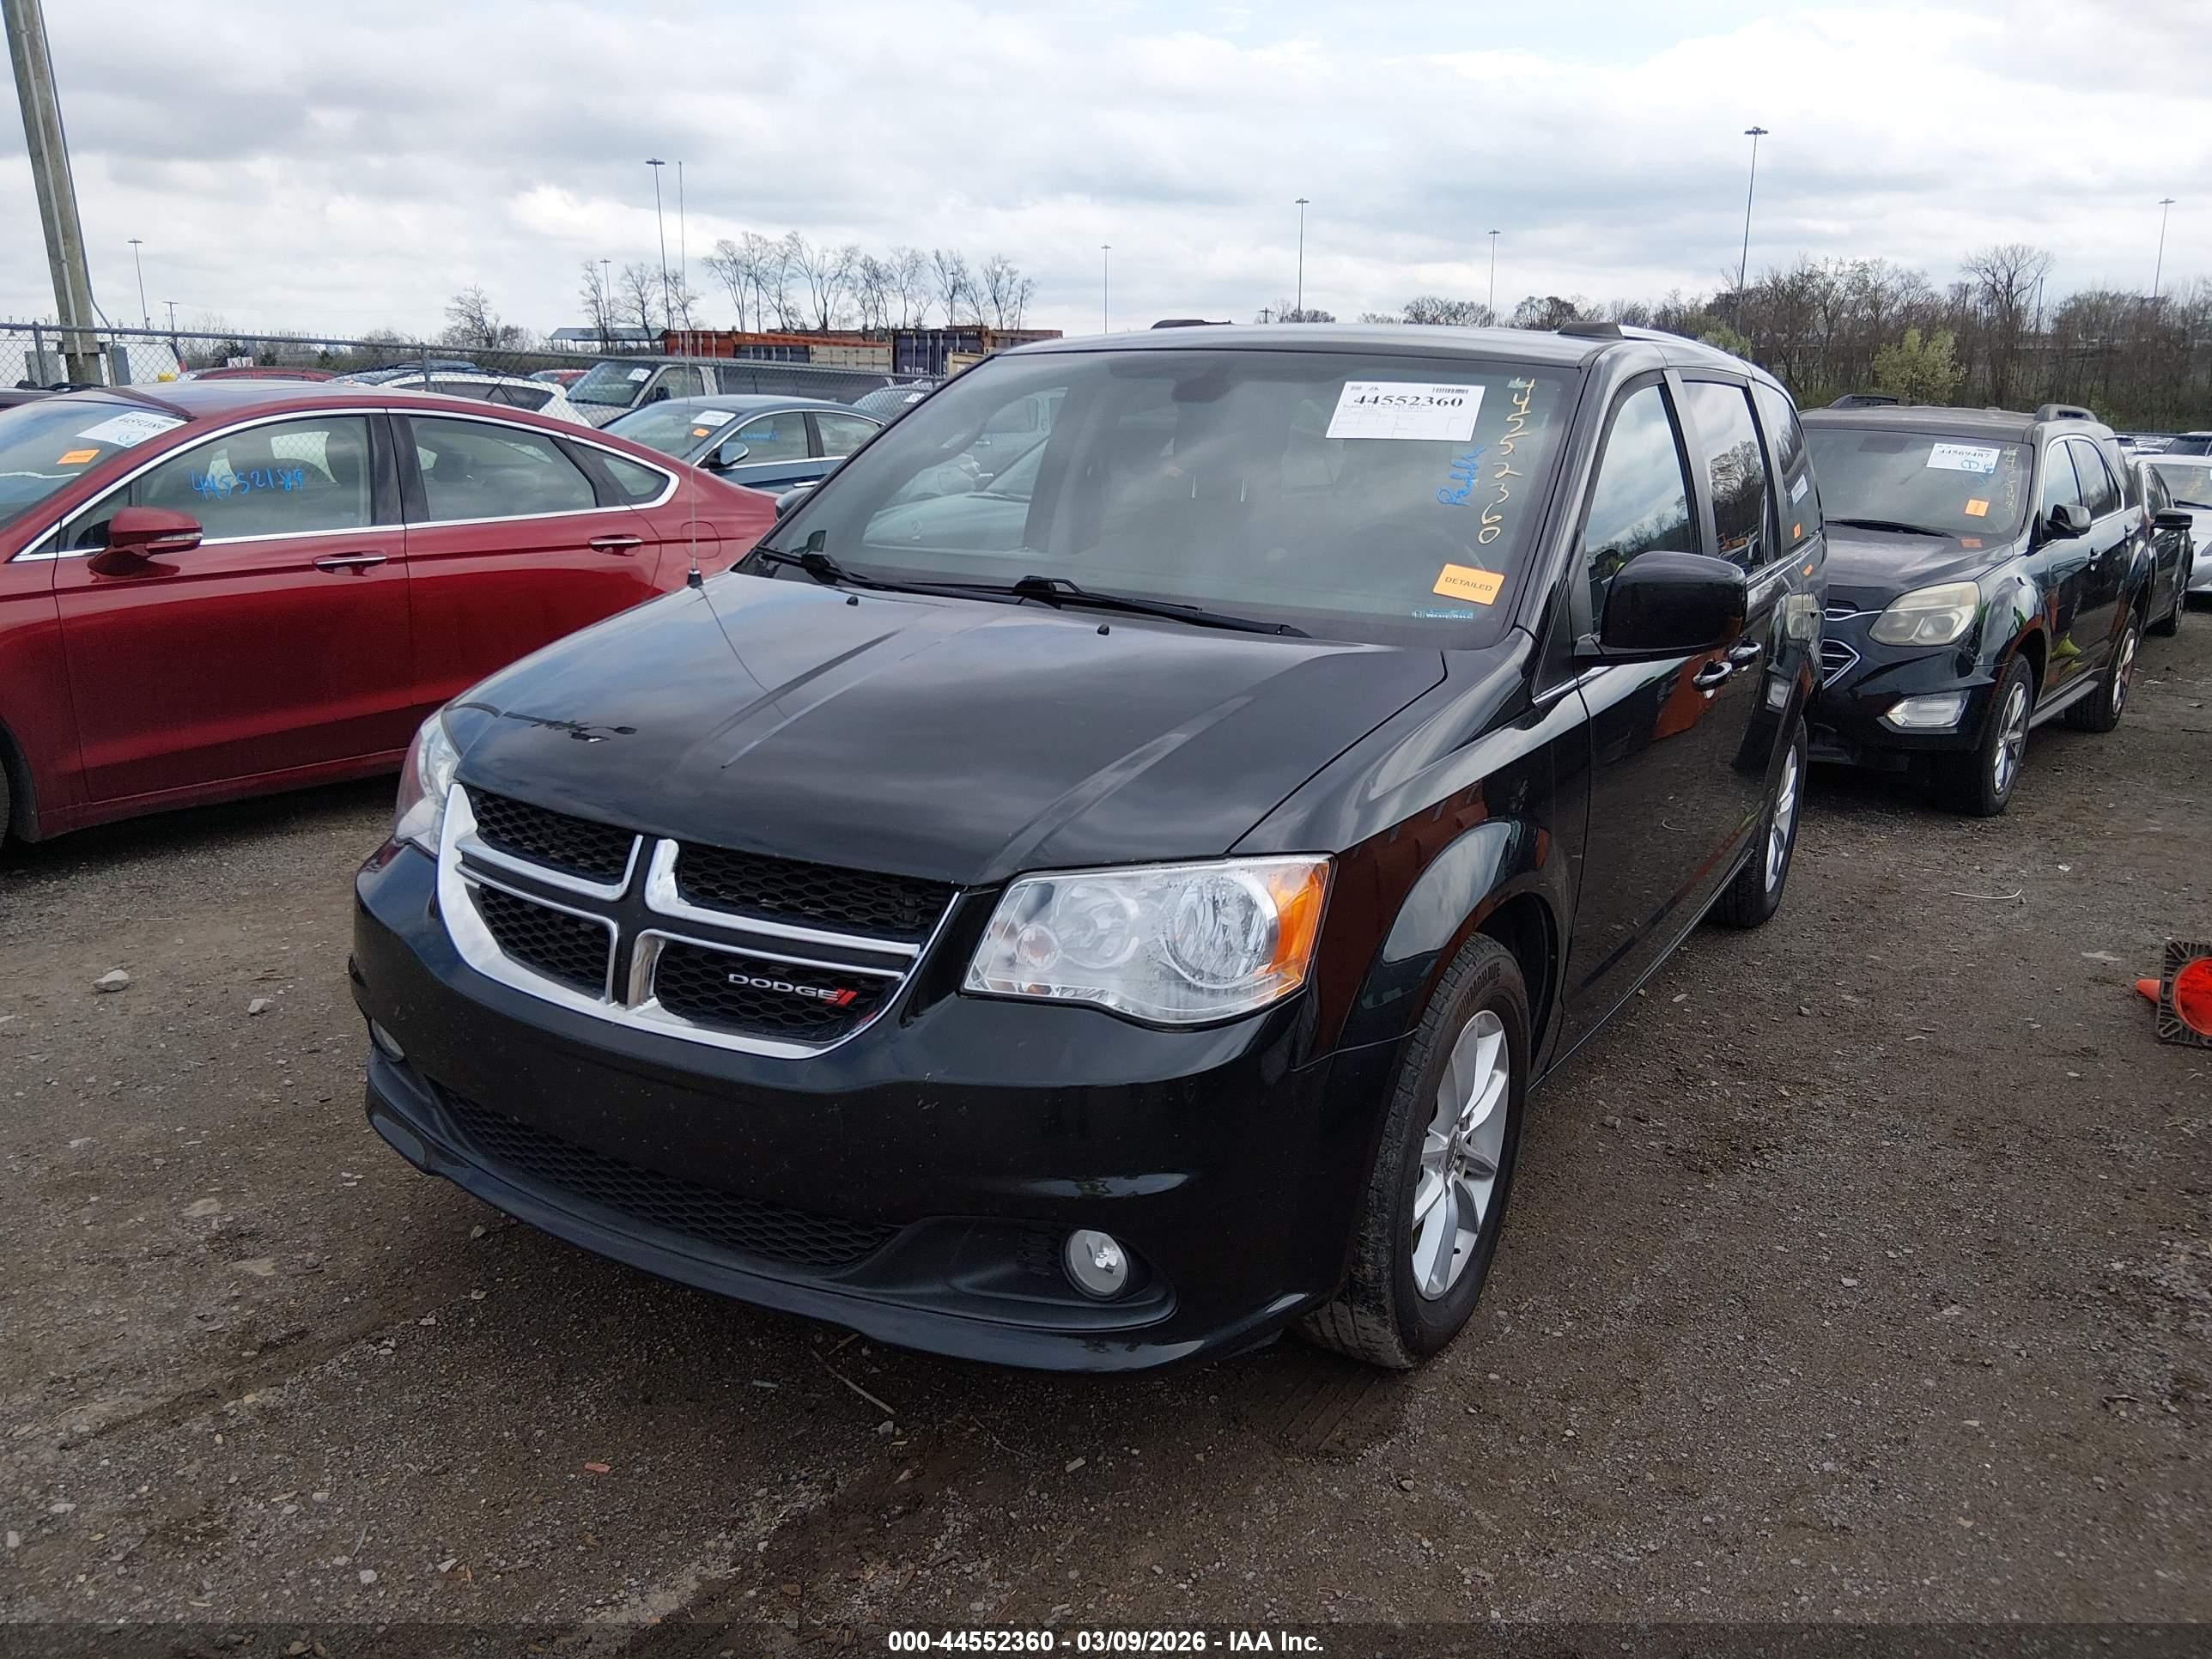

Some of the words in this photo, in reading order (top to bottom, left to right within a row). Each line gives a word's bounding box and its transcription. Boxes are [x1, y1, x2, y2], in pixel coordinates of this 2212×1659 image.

[1353, 394, 1463, 408] 44552360
[1478, 376, 1535, 544] 44552360
[1444, 576, 1493, 592] DETAILED
[728, 973, 838, 1000] DODGE
